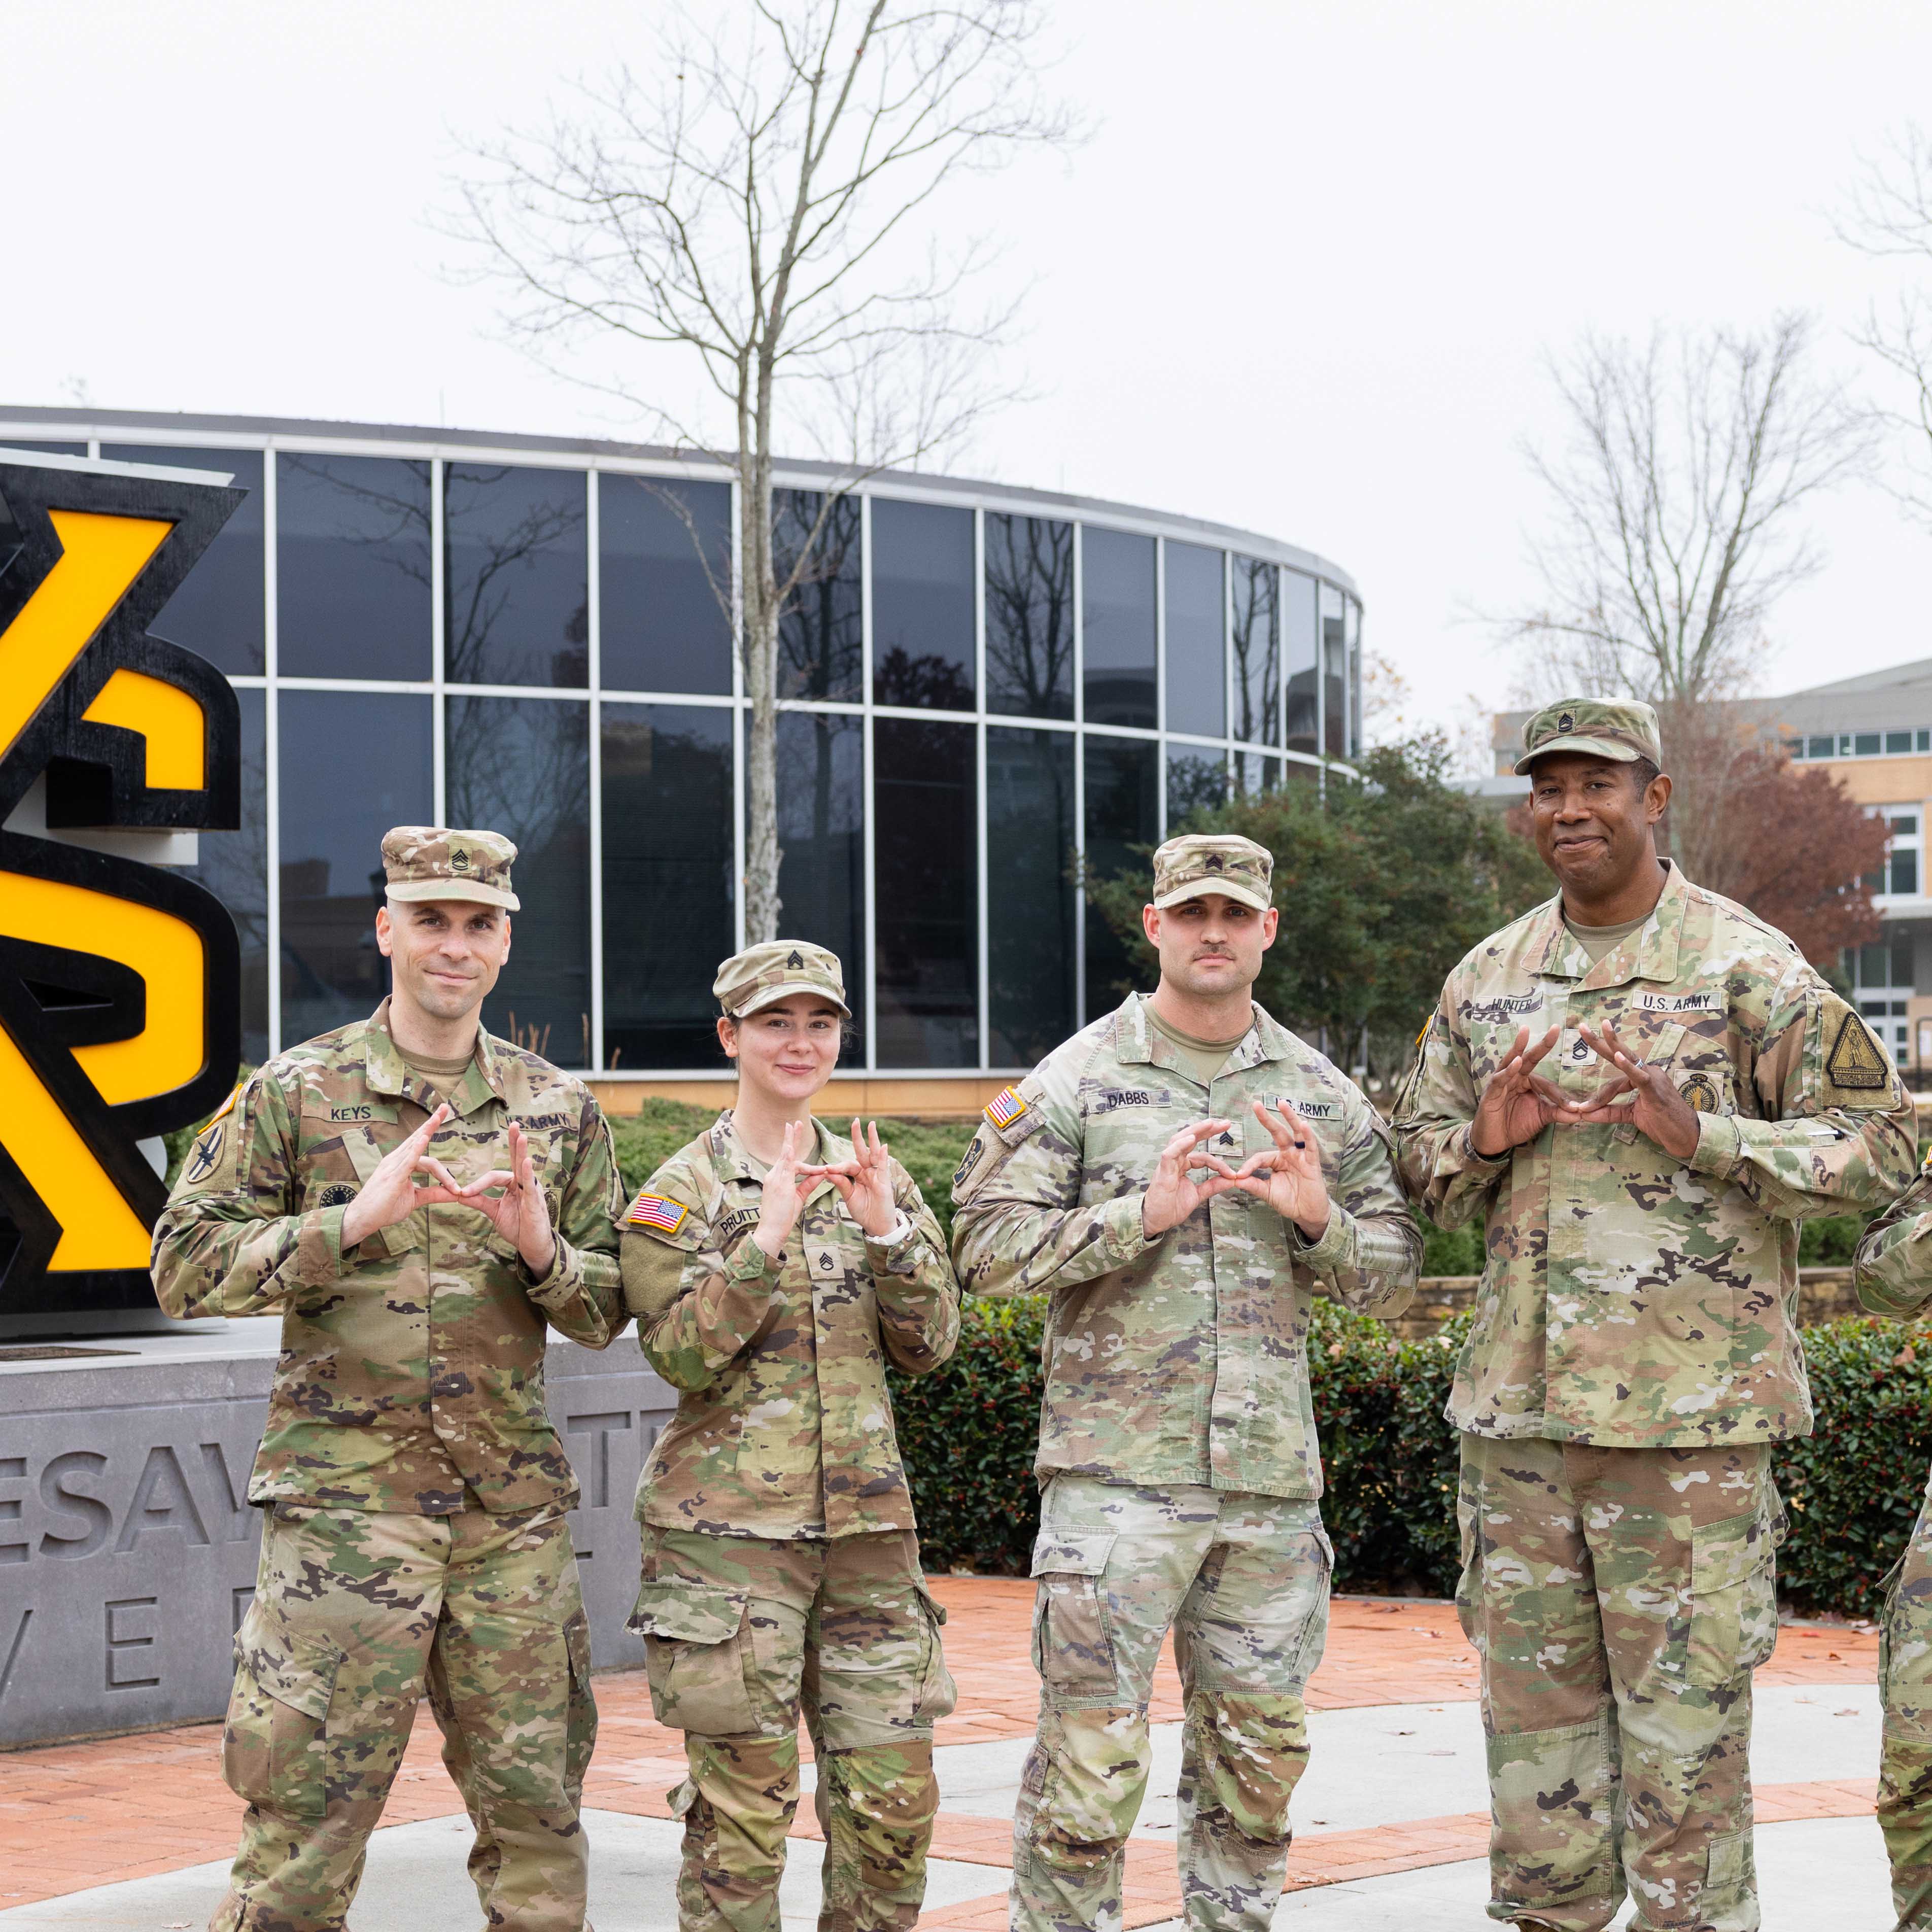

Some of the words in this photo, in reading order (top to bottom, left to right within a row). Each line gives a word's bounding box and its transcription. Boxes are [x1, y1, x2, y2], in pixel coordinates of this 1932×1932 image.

[1491, 998, 1532, 1011] HUNTER
[1644, 995, 1668, 1010] U.S.
[1673, 995, 1711, 1011] ARMY
[1108, 1091, 1149, 1108] DABBS
[331, 1106, 371, 1120] KEYS
[1299, 1102, 1330, 1117] ARMY
[505, 1116, 528, 1129] US.
[530, 1113, 567, 1130] ARMY
[720, 1208, 761, 1235] PRUITT
